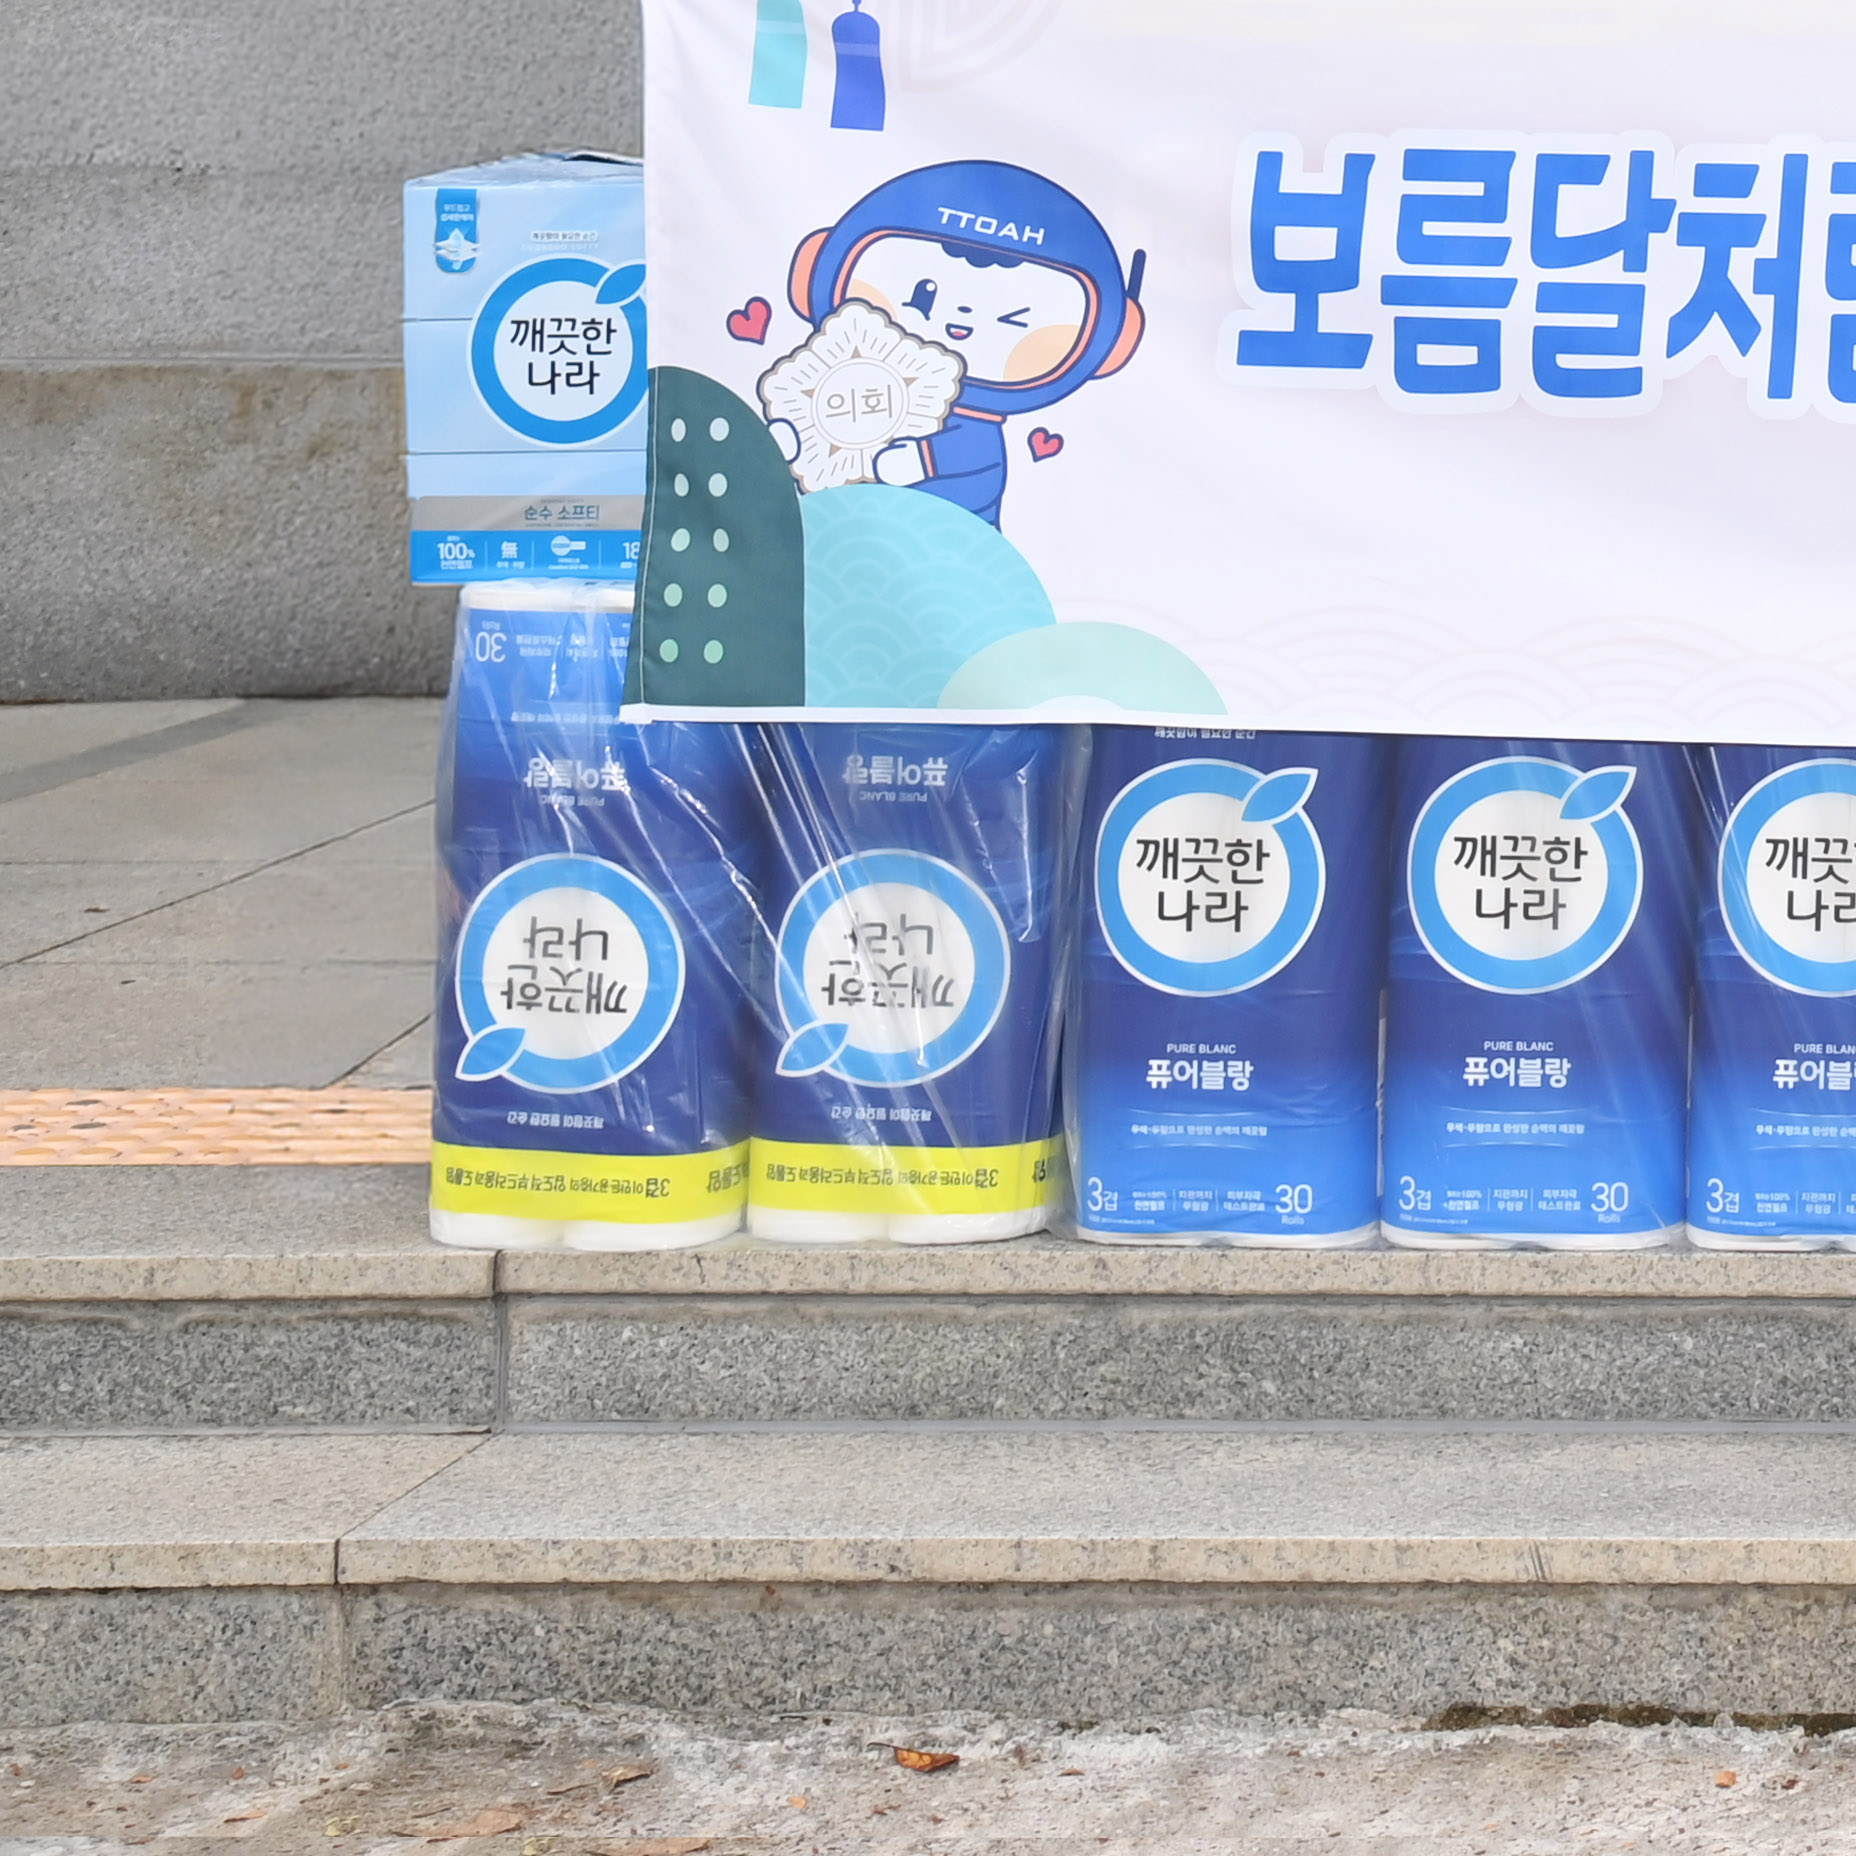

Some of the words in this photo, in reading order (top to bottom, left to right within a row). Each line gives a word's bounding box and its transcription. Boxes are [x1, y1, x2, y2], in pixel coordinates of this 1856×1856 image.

[936, 205, 1047, 247] TTOAH
[509, 317, 617, 356] 깨끗한
[527, 360, 601, 395] 나라
[825, 382, 896, 427] 의회
[524, 504, 553, 521] 순수
[557, 504, 600, 521] 소프티
[437, 542, 475, 559] 100%
[475, 631, 507, 663] 30
[842, 753, 949, 786] 퓨어블랑
[1136, 836, 1271, 886] 깨끗한
[1453, 834, 1588, 884] 깨끗한
[1157, 889, 1249, 933] 나라
[1475, 887, 1567, 931] 나라
[523, 916, 609, 961] 나라
[848, 913, 934, 956] 나라
[500, 964, 628, 1014] 깨끗한
[820, 962, 954, 1011] 깨끗한
[1167, 1043, 1196, 1055] PURE
[1198, 1043, 1237, 1055] BLANC
[1483, 1040, 1514, 1052] PURE
[1516, 1040, 1554, 1052] BLANC
[1793, 1043, 1824, 1055] PURE
[1146, 1059, 1254, 1091] 퓨어블랑
[1462, 1056, 1571, 1089] 퓨어블랑
[507, 1111, 528, 1125] 순간
[446, 1166, 473, 1185] 도톰함
[475, 1170, 530, 1191] 부드러움과
[531, 1173, 566, 1193] 압도적
[1087, 1176, 1118, 1212] 3겹
[1275, 1183, 1313, 1214] 30
[1398, 1175, 1431, 1211] 3겹
[1590, 1181, 1629, 1213] 30
[1706, 1177, 1740, 1213] 3겹
